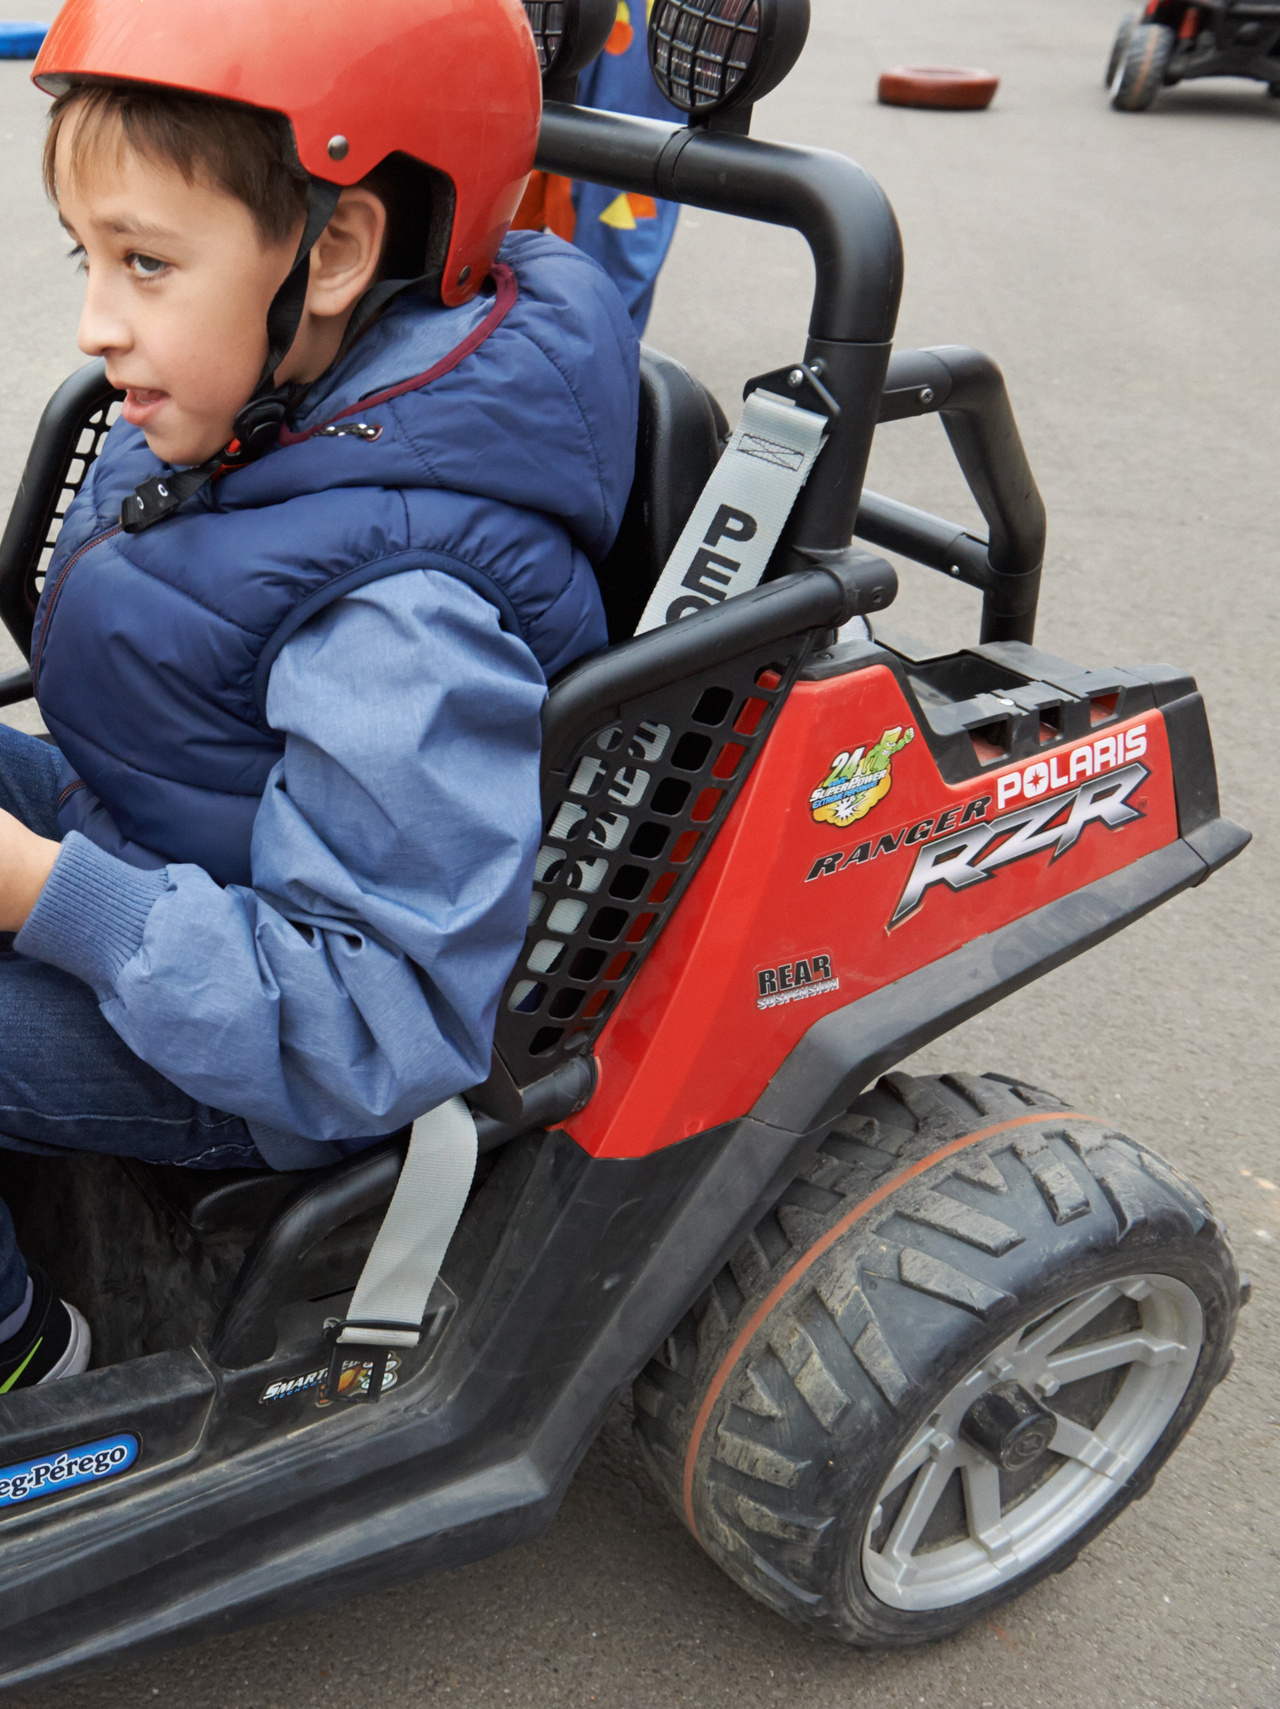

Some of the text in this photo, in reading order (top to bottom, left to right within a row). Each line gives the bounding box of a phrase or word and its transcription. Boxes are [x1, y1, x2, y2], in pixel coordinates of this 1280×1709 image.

[822, 746, 865, 788] 24
[997, 724, 1147, 810] POLARIS
[804, 795, 993, 883] RANGER
[886, 761, 1152, 931] RZR
[756, 977, 840, 1010] SUSPENSION
[758, 954, 832, 996] REAR
